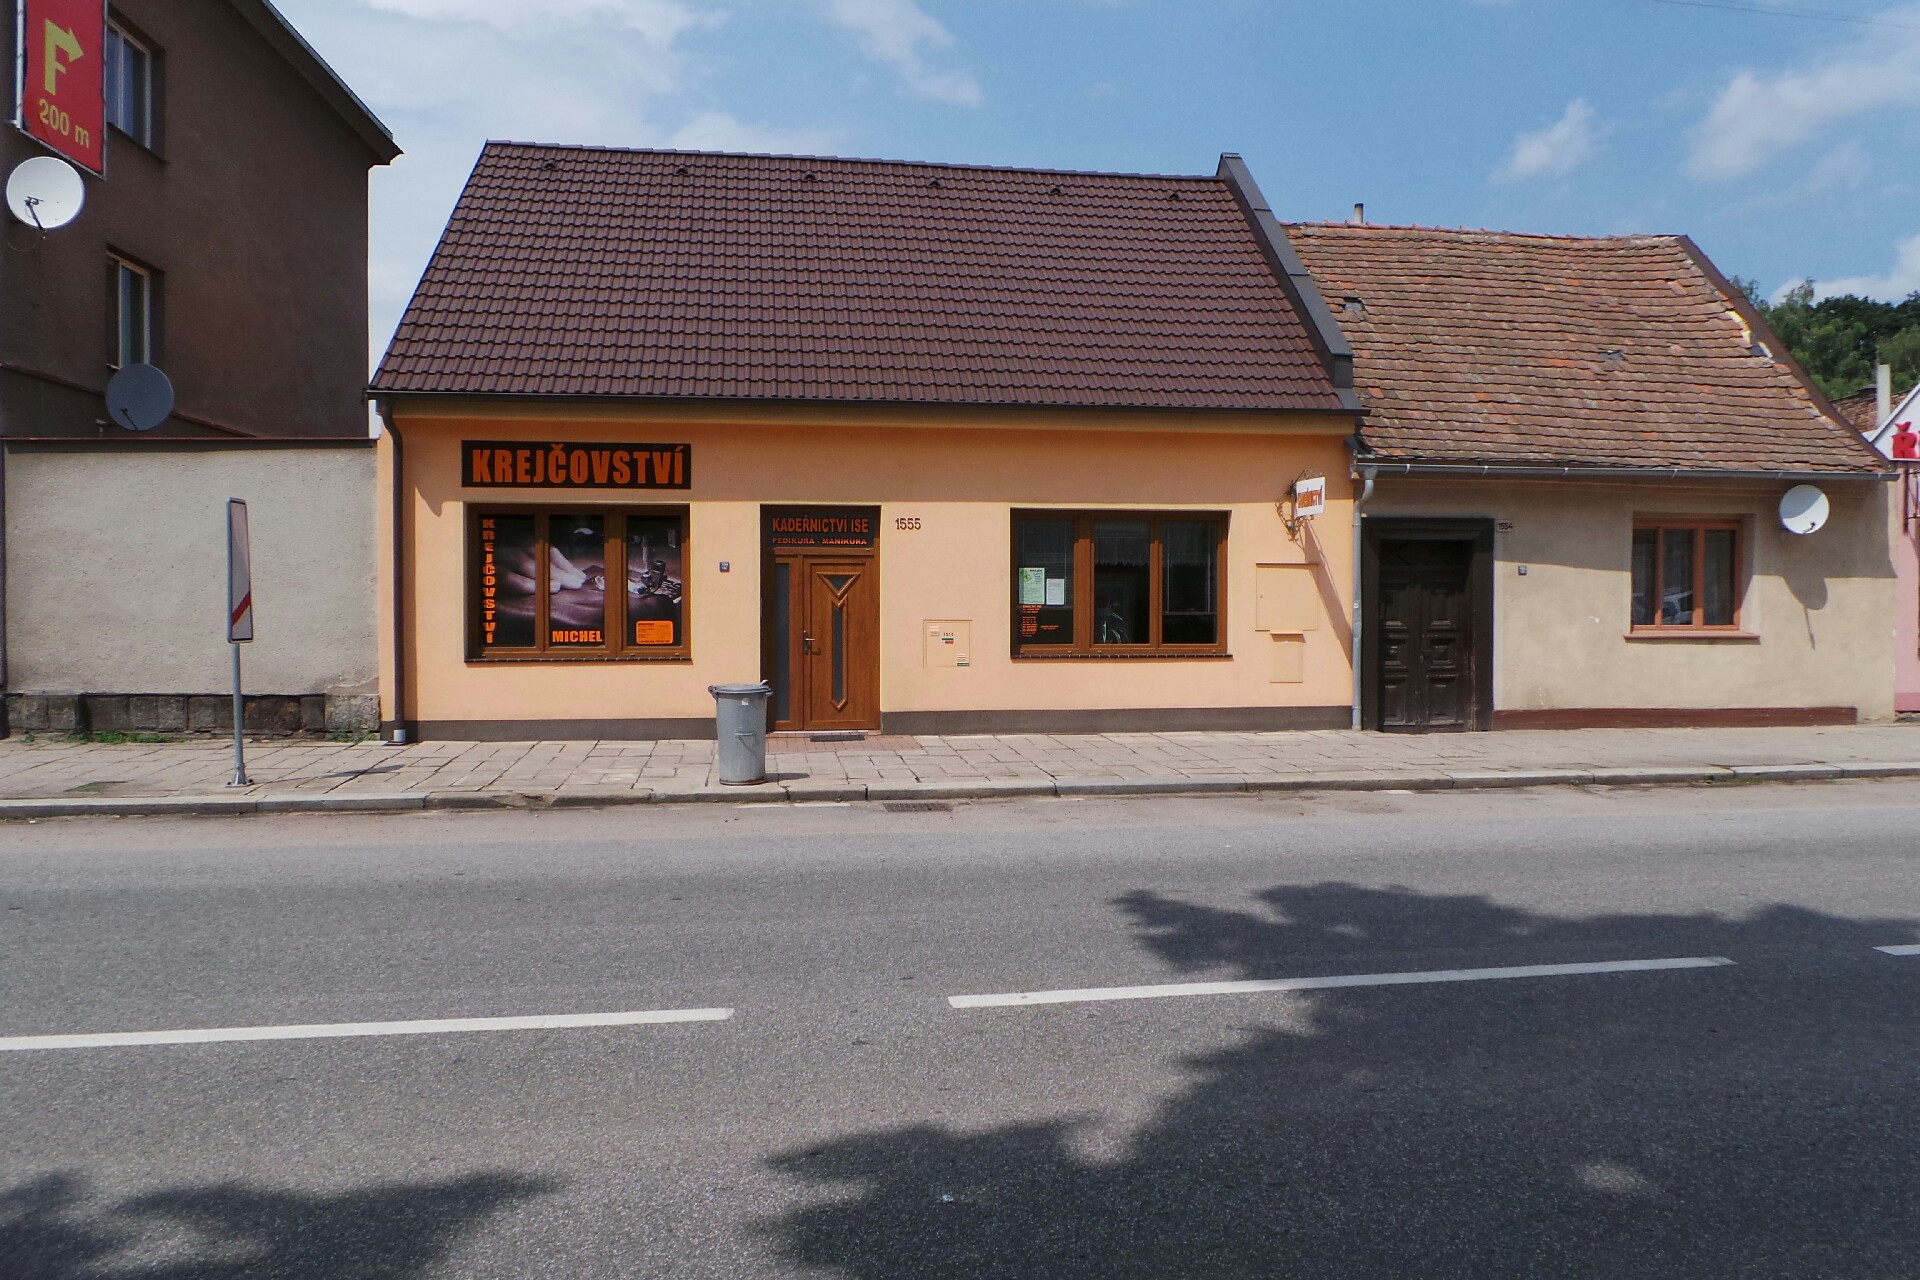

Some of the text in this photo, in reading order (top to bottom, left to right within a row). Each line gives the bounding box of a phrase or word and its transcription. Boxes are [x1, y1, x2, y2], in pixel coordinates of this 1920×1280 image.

[38, 97, 90, 149] 200 m
[1892, 421, 1920, 459] Ř
[472, 443, 683, 485] KREJČOVSTVÍ
[895, 517, 922, 530] 1555
[552, 630, 602, 642] MICHEL
